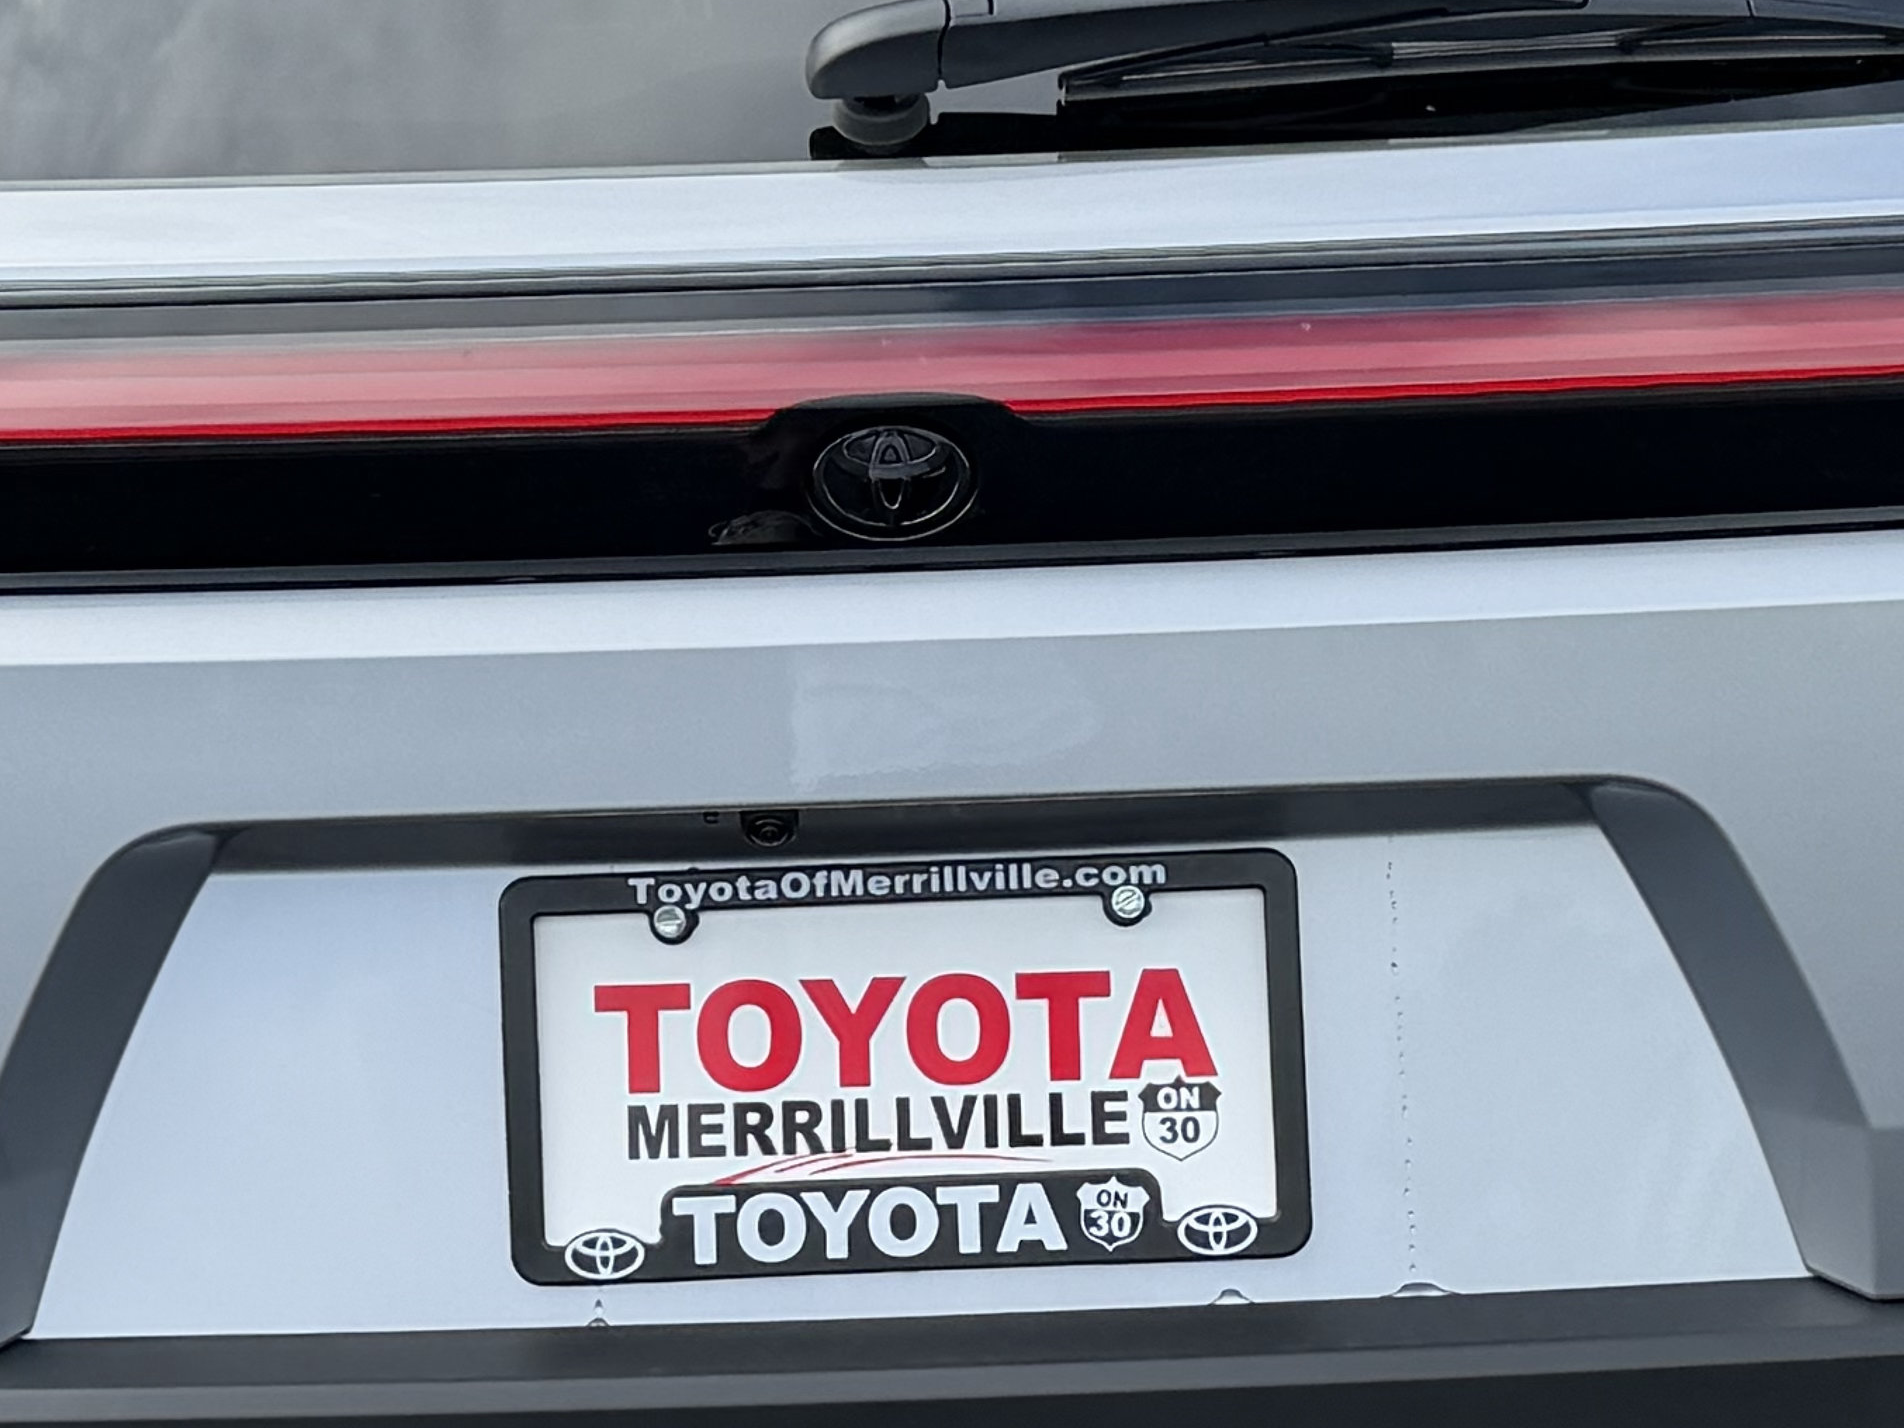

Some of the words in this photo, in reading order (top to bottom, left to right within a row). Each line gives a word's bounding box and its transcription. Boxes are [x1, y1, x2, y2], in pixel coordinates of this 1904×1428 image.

[628, 860, 1166, 909] ToyotaOfMerrillville.com
[594, 967, 1218, 1094] TOYOTA
[1156, 1086, 1200, 1110] ON
[627, 1090, 1131, 1160] MERRILLVILLE
[1159, 1116, 1201, 1144] 30
[1096, 1189, 1128, 1209] ON
[672, 1182, 1068, 1265] TOYOTA
[1089, 1210, 1132, 1238] 30
